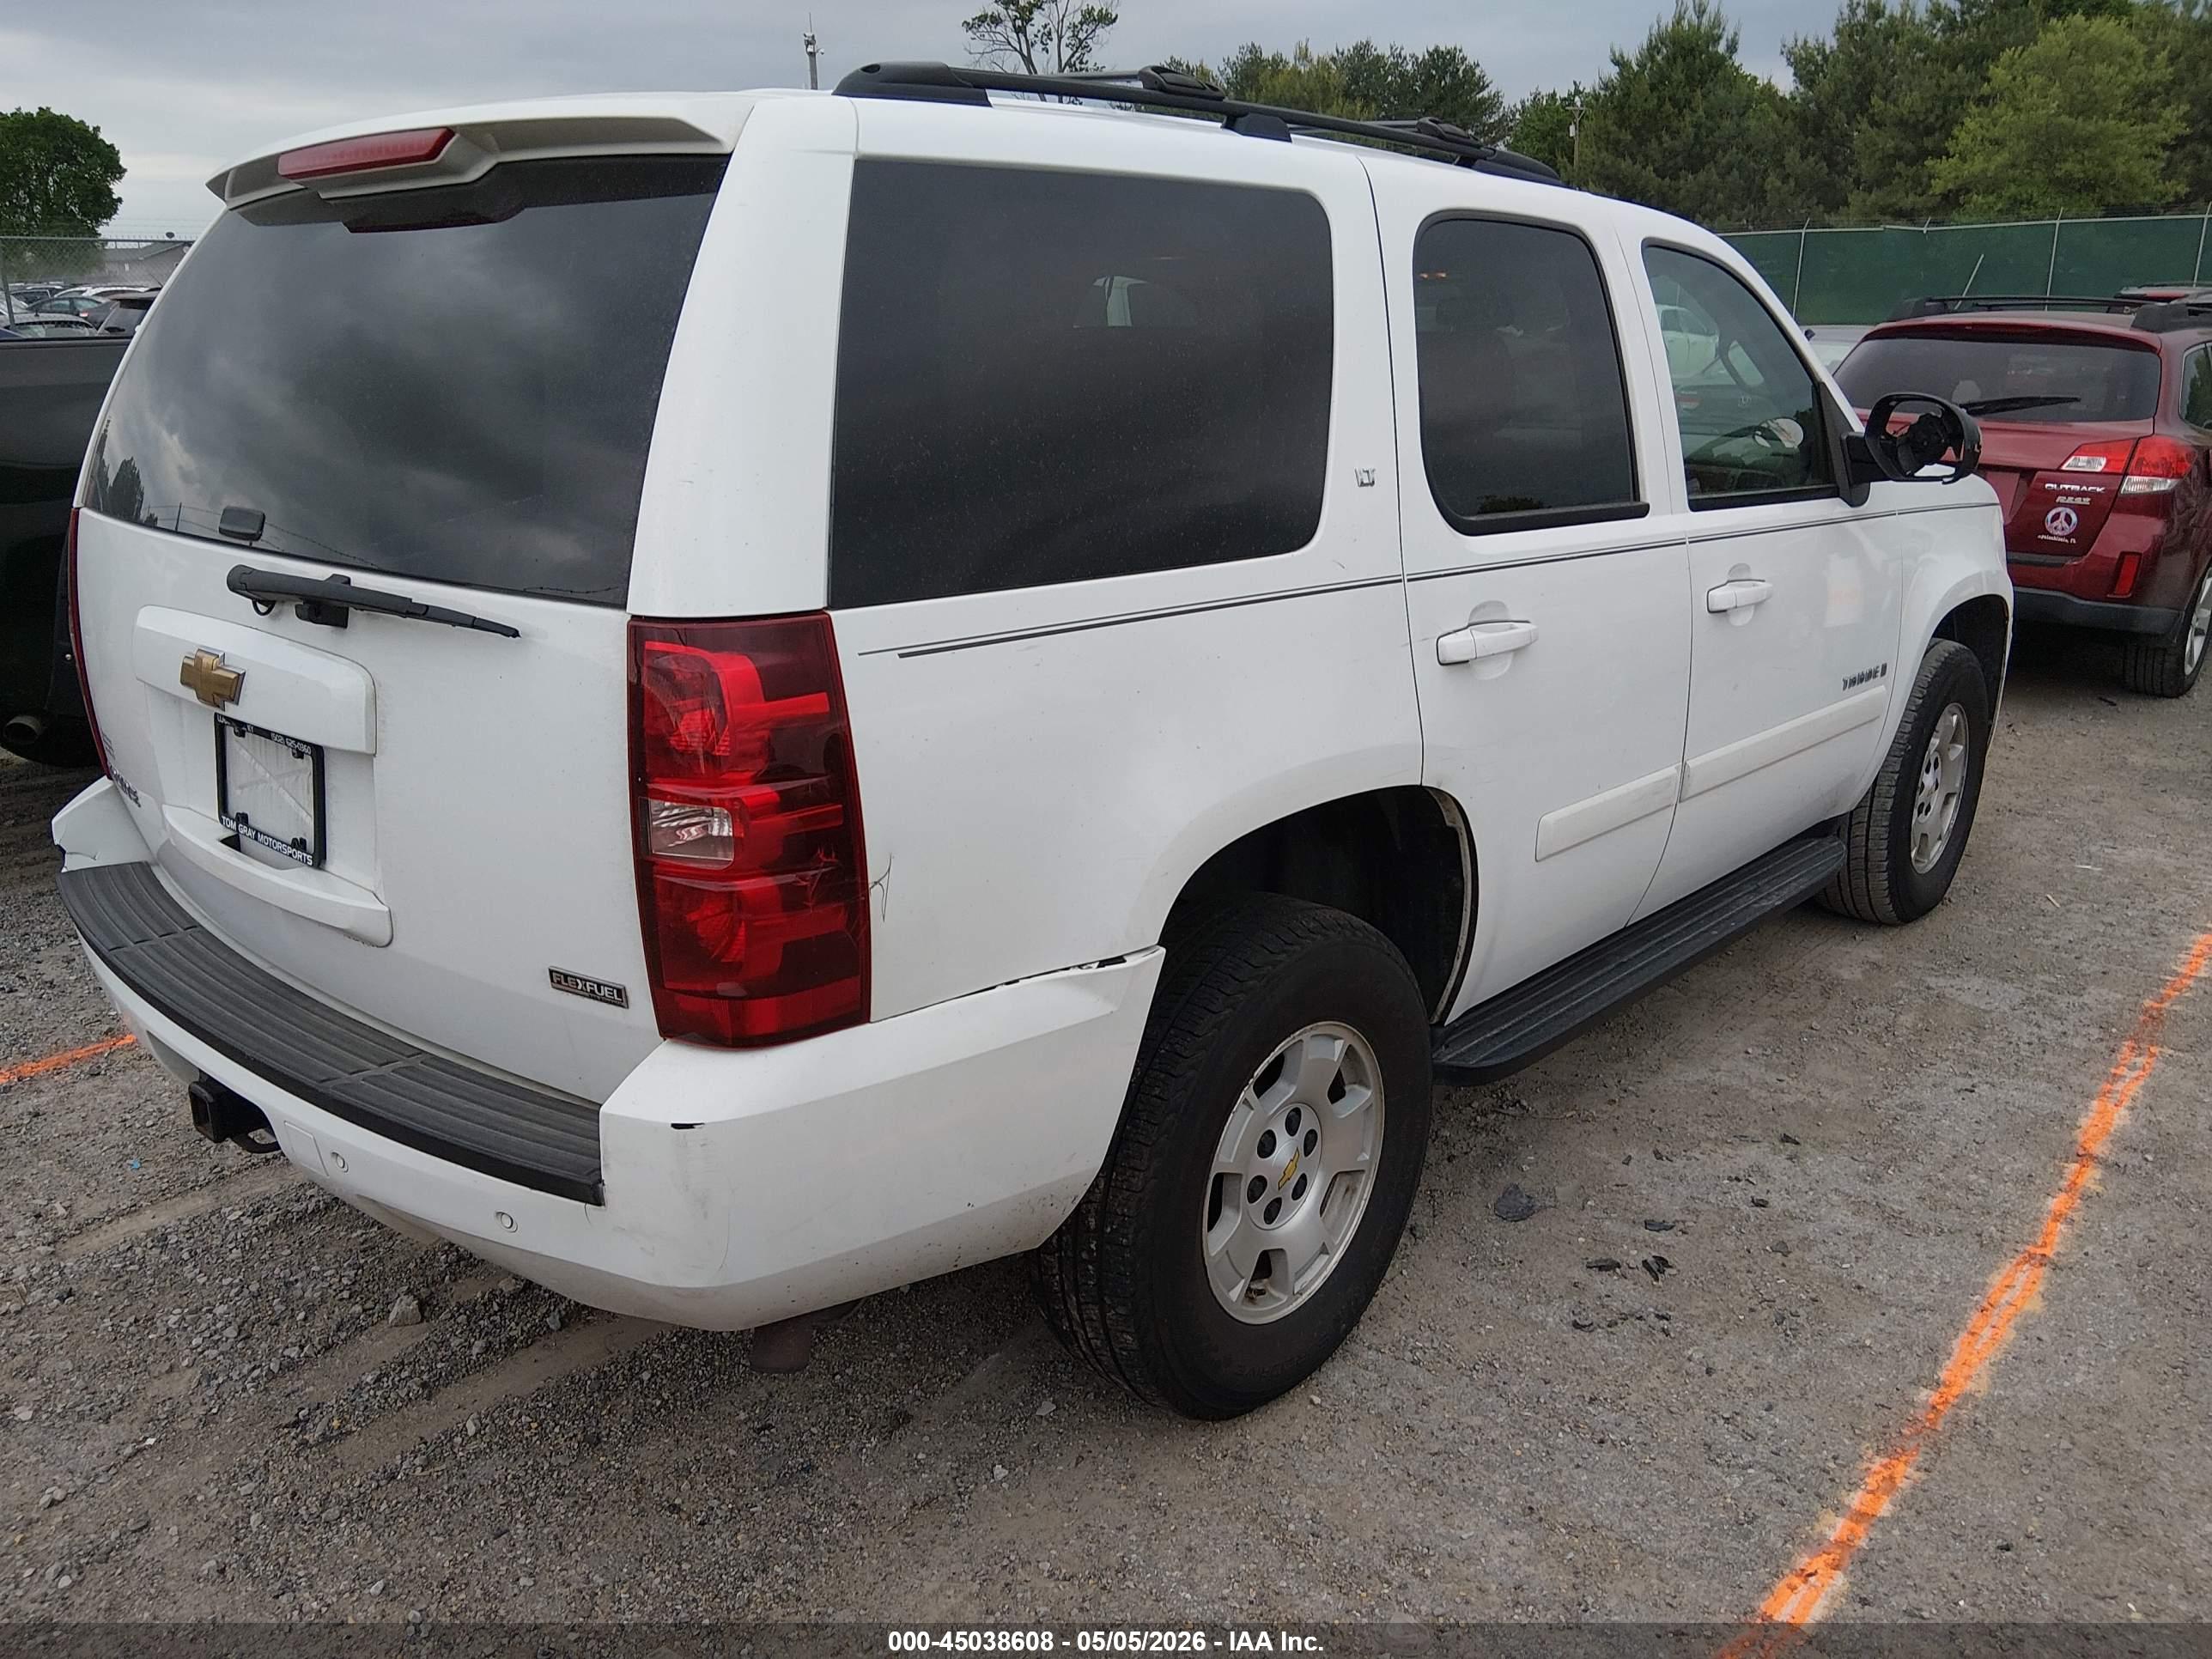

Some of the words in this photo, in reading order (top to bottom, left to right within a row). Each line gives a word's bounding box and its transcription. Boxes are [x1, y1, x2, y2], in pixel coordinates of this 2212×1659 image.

[2045, 483, 2106, 493] OUTBACK
[222, 816, 236, 831] TOM
[238, 824, 257, 840] GRAY
[258, 832, 313, 866] MOTORSPORTS
[552, 972, 623, 1001] FLEXFUEL
